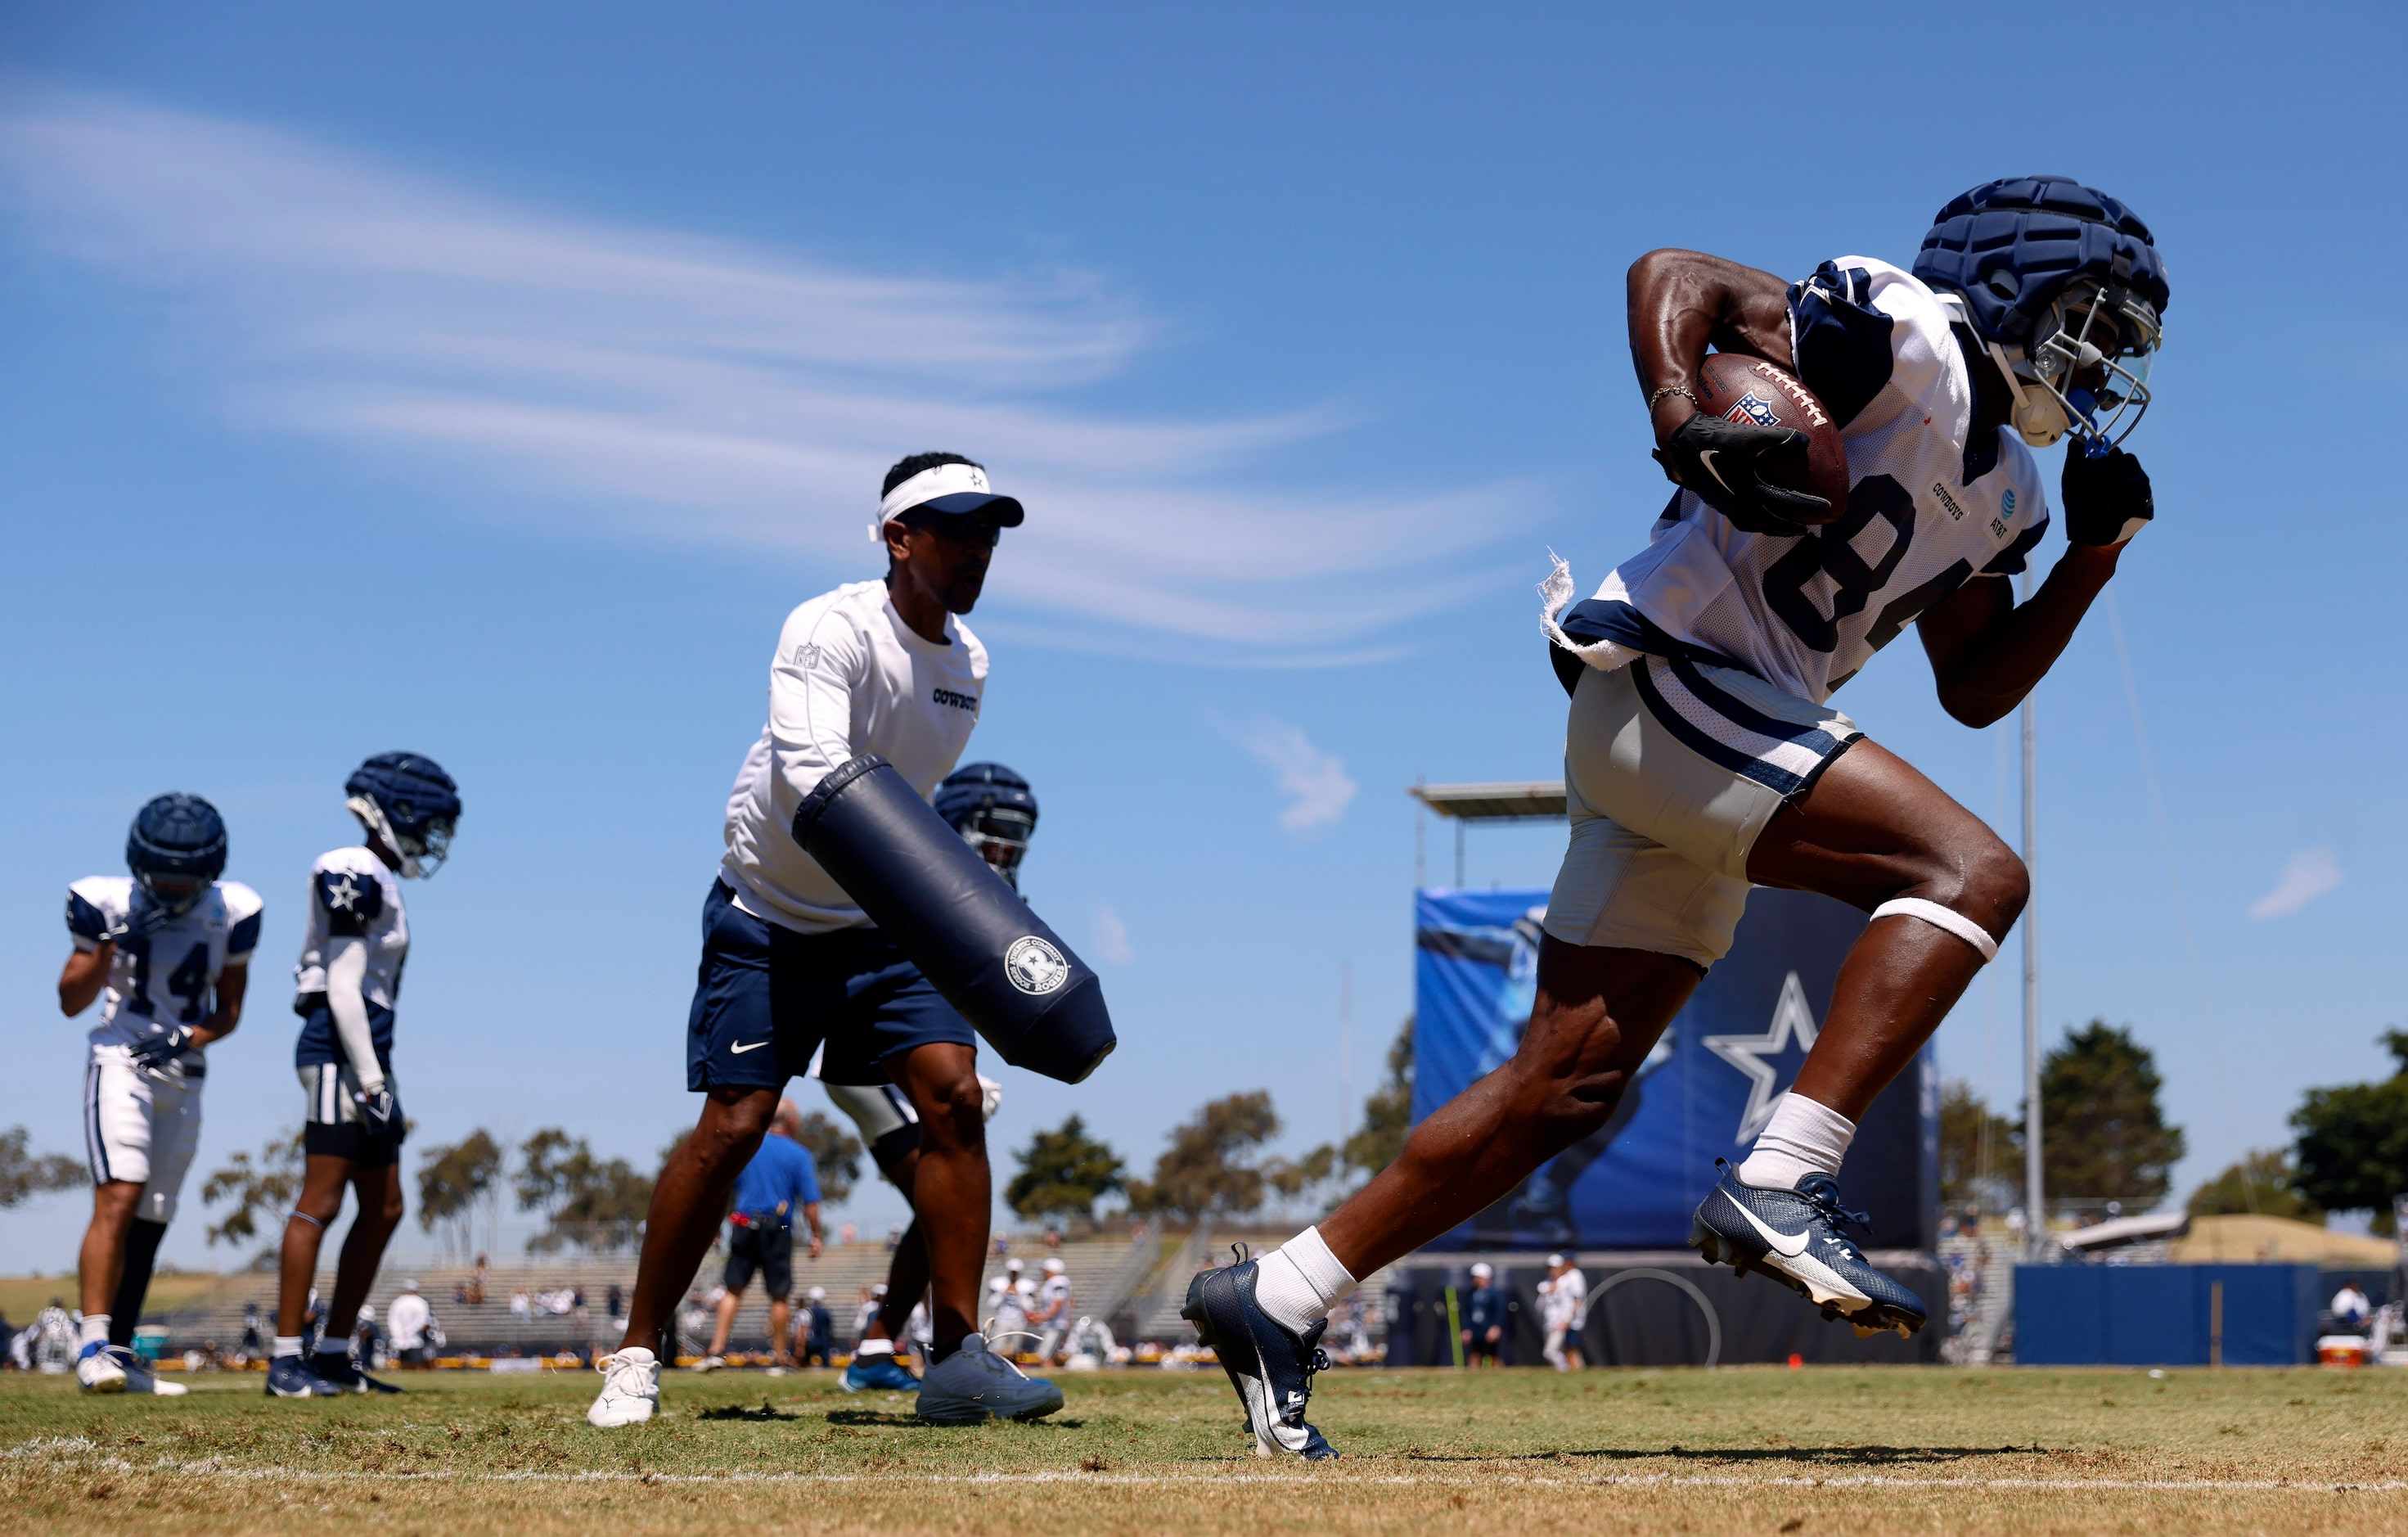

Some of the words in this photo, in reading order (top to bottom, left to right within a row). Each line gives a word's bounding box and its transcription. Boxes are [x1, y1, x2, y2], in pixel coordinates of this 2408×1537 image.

[1933, 482, 1964, 521] COWBOYS
[1989, 516, 2007, 539] AT&T
[123, 937, 209, 1023] 14
[1034, 965, 1064, 992] ROGERS
